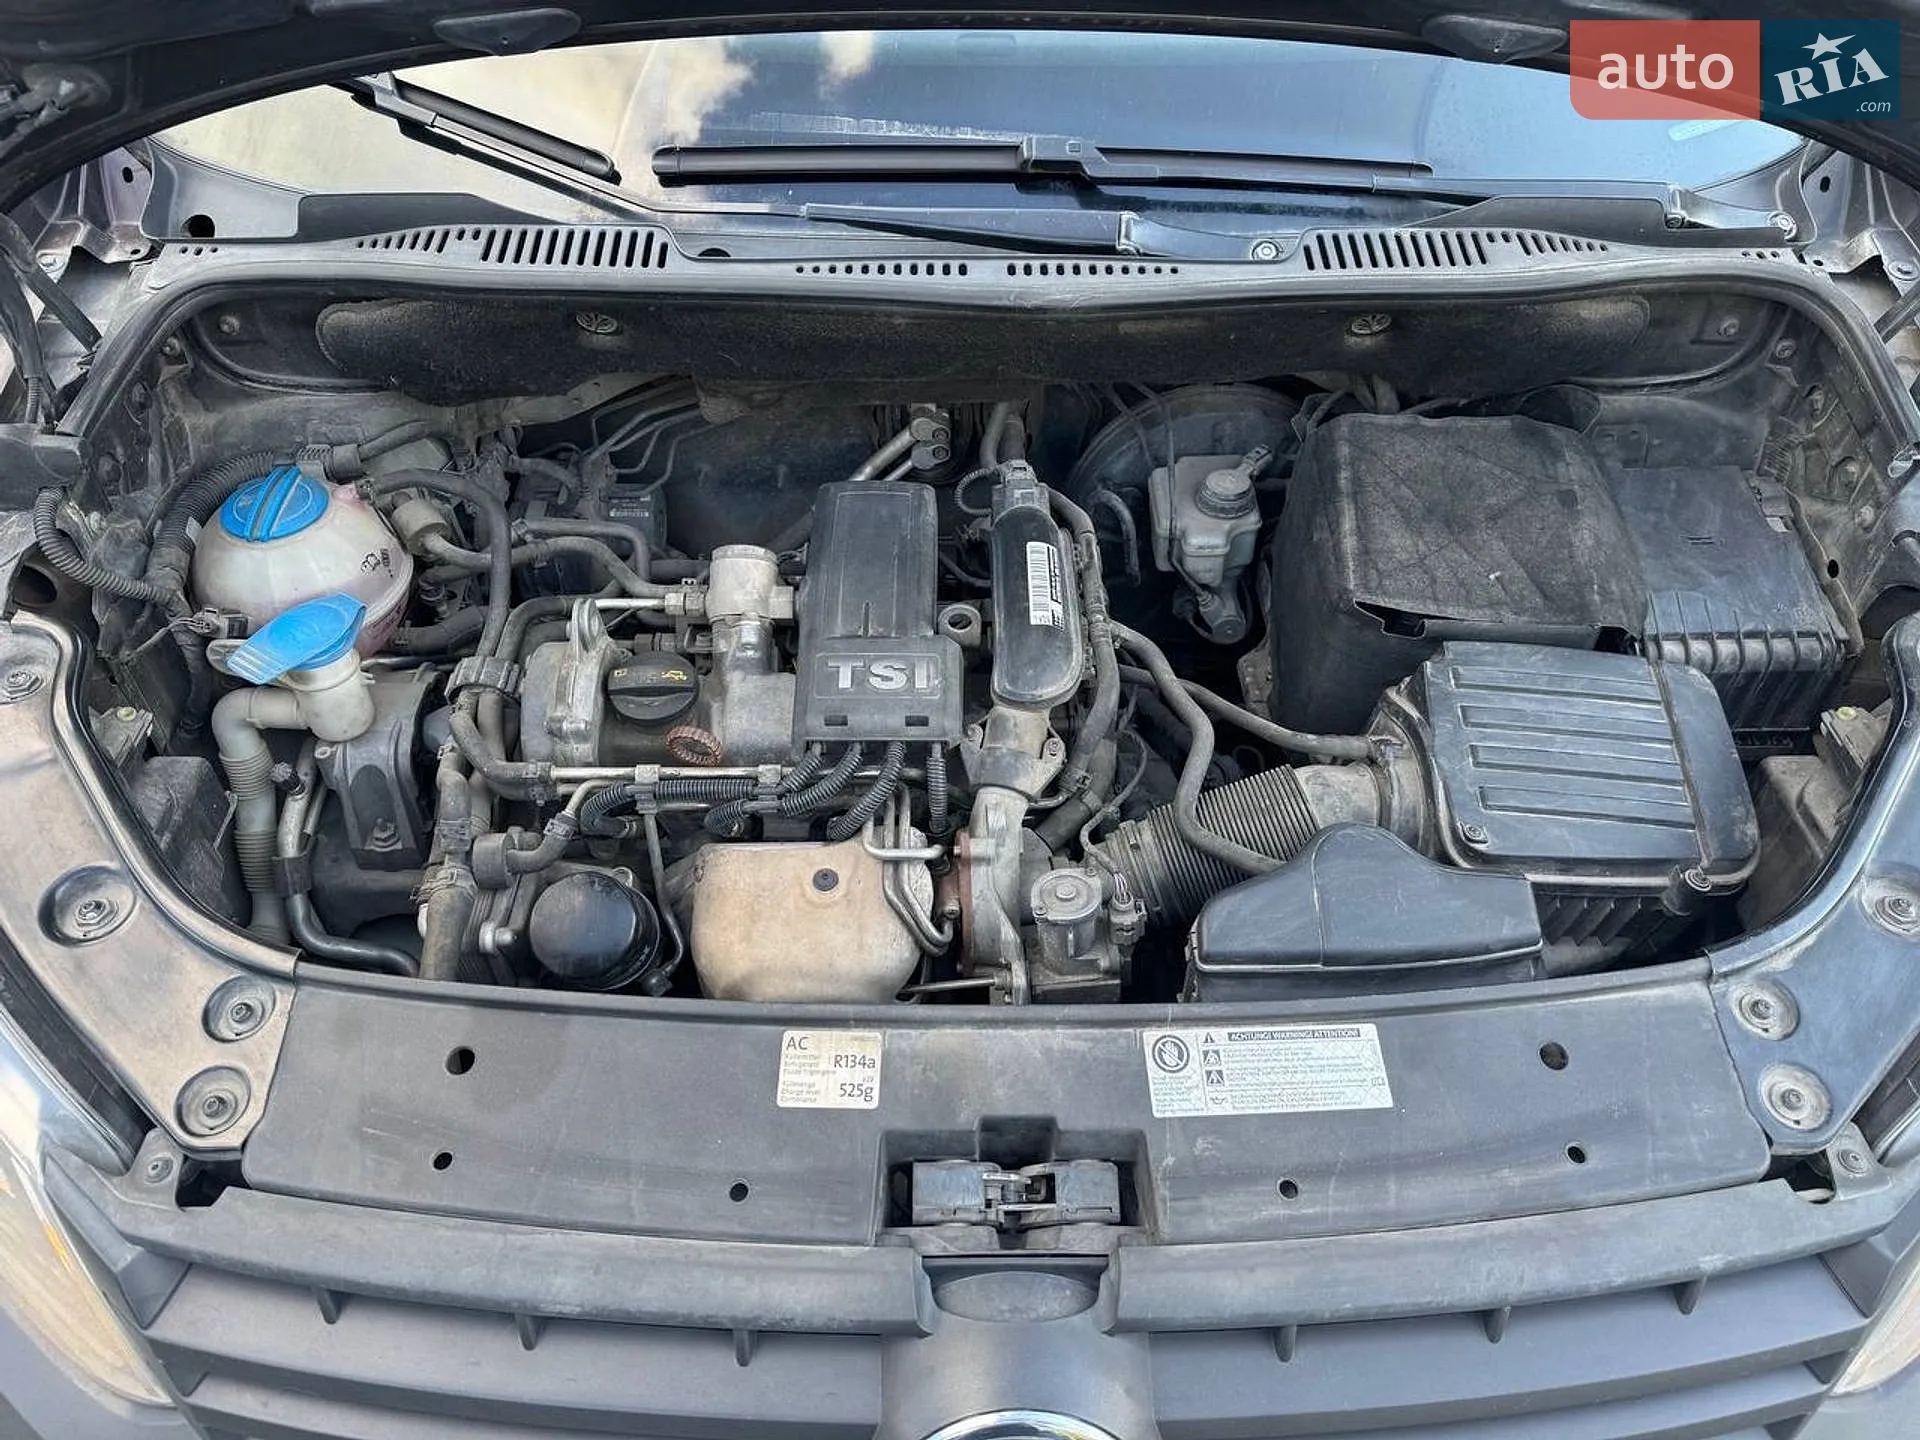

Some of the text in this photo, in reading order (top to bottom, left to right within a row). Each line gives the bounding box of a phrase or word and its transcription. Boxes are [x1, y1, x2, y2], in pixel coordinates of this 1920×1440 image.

[827, 657, 929, 691] TSI
[786, 1036, 809, 1050] AC
[833, 1054, 876, 1069] R134a
[839, 1083, 874, 1102] 525g
